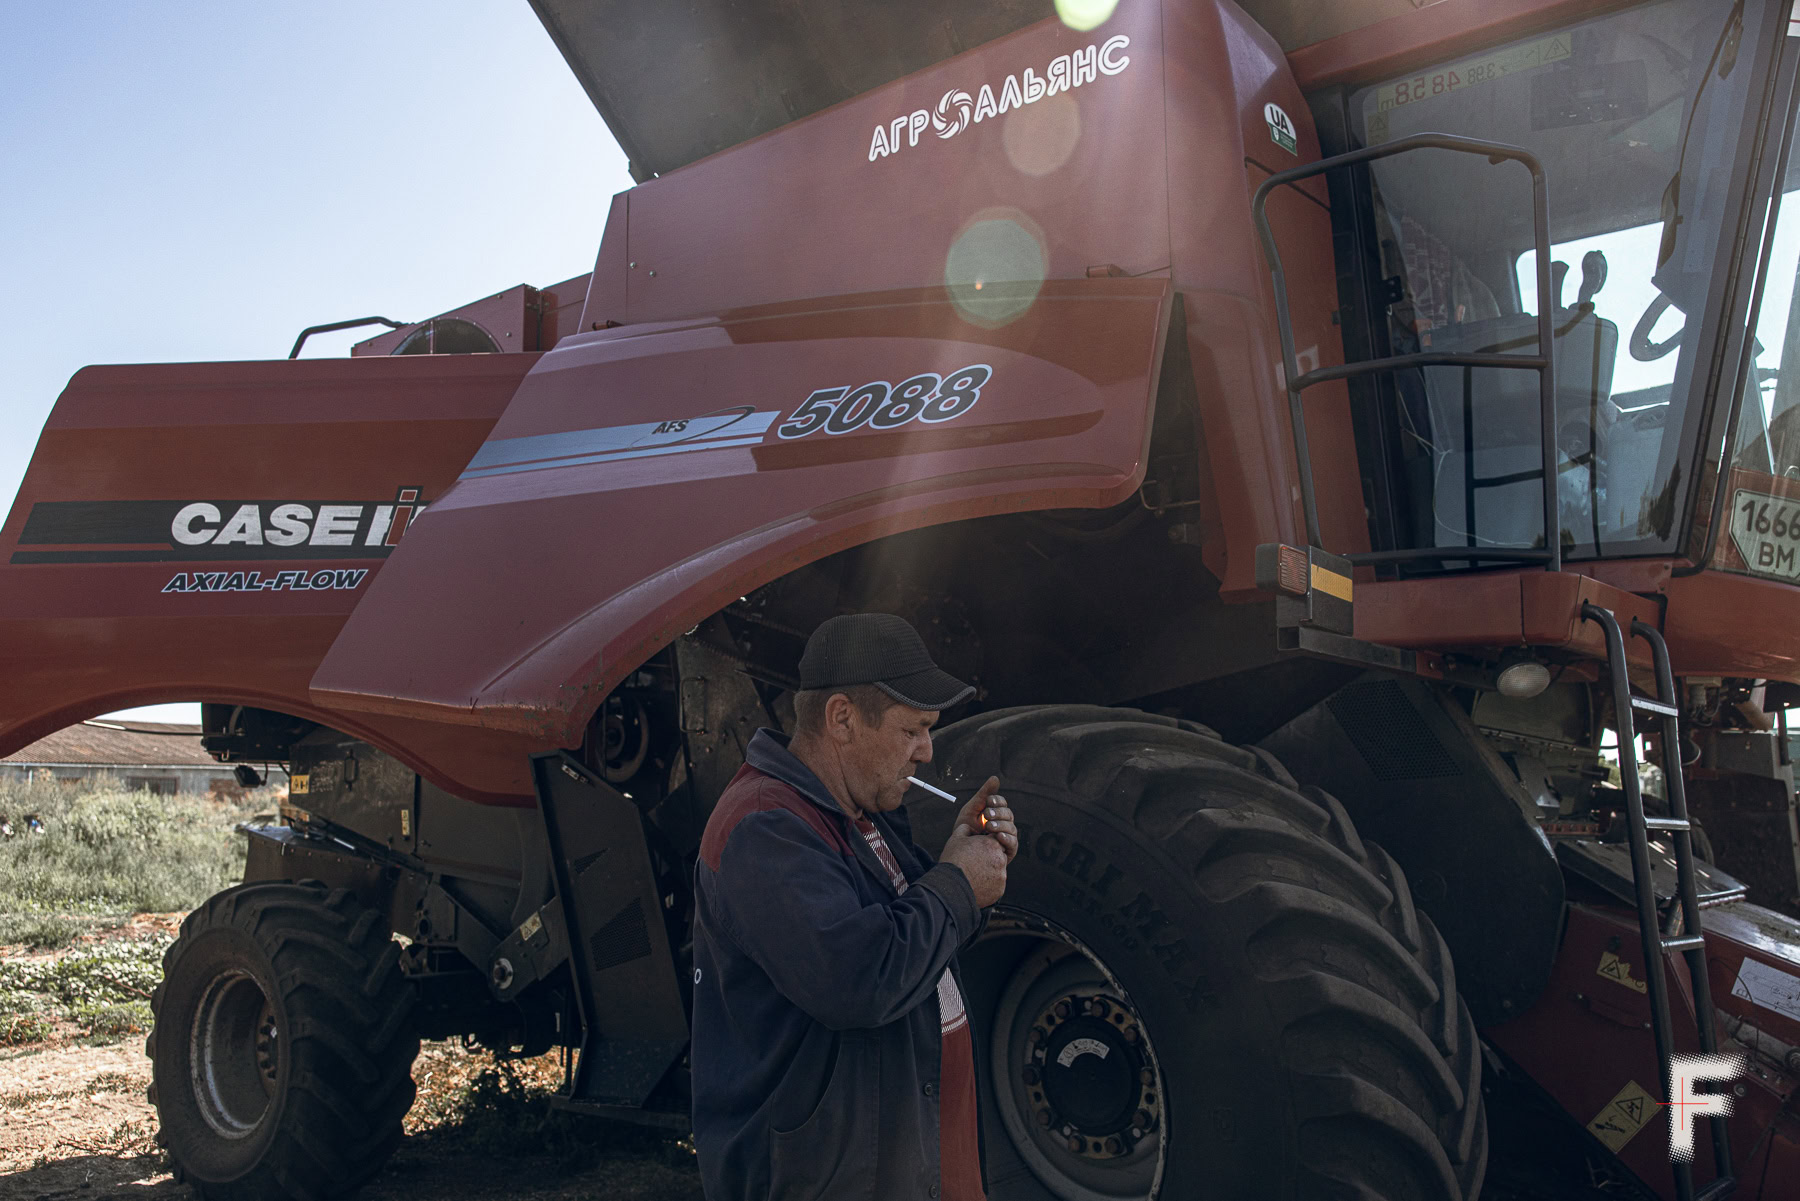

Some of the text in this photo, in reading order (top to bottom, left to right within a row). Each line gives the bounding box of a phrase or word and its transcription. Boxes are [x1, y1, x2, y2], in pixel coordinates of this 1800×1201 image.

[1269, 106, 1290, 134] UA
[777, 363, 993, 440] 5088
[651, 419, 689, 435] AFS
[171, 502, 363, 546] CASE
[1741, 499, 1800, 541] 1666
[161, 568, 369, 593] AXIAL-FLOW
